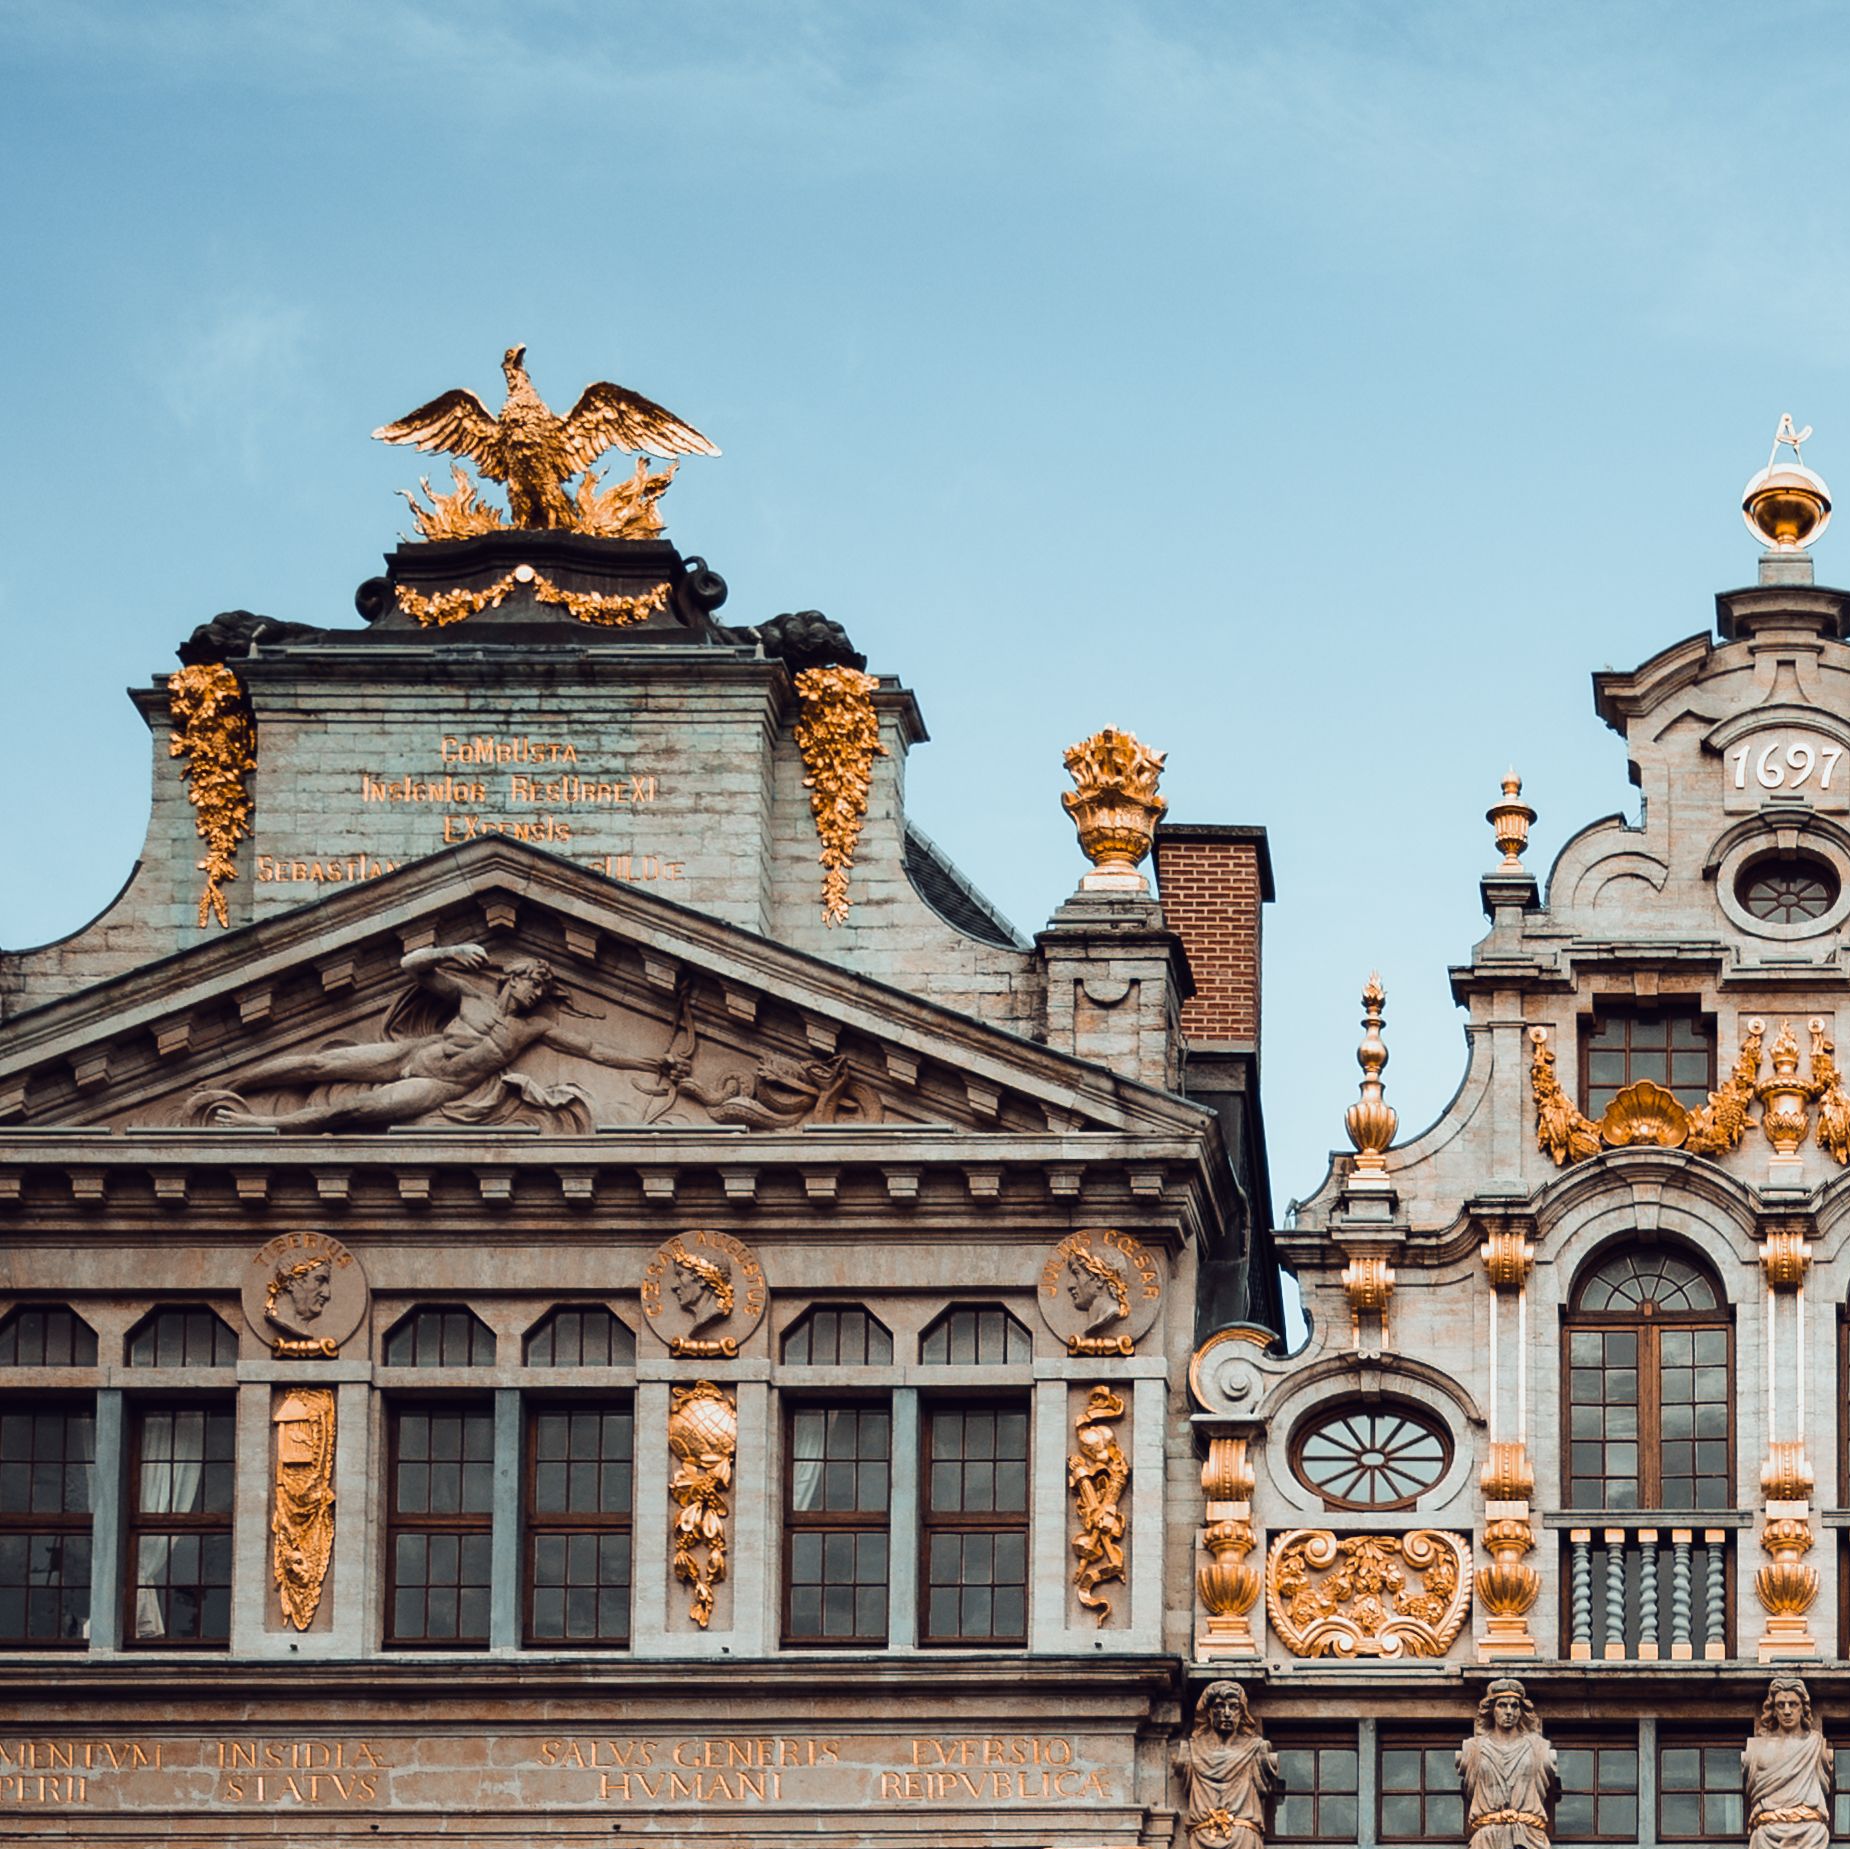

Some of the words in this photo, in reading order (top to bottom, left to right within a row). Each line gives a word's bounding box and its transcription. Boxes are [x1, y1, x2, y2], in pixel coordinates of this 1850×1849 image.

[1732, 742, 1844, 790] 1697
[536, 1738, 658, 1769] SALVS
[673, 1738, 841, 1769] GENERIS
[222, 1774, 381, 1802] STATVS
[599, 1771, 783, 1801] HVMANI
